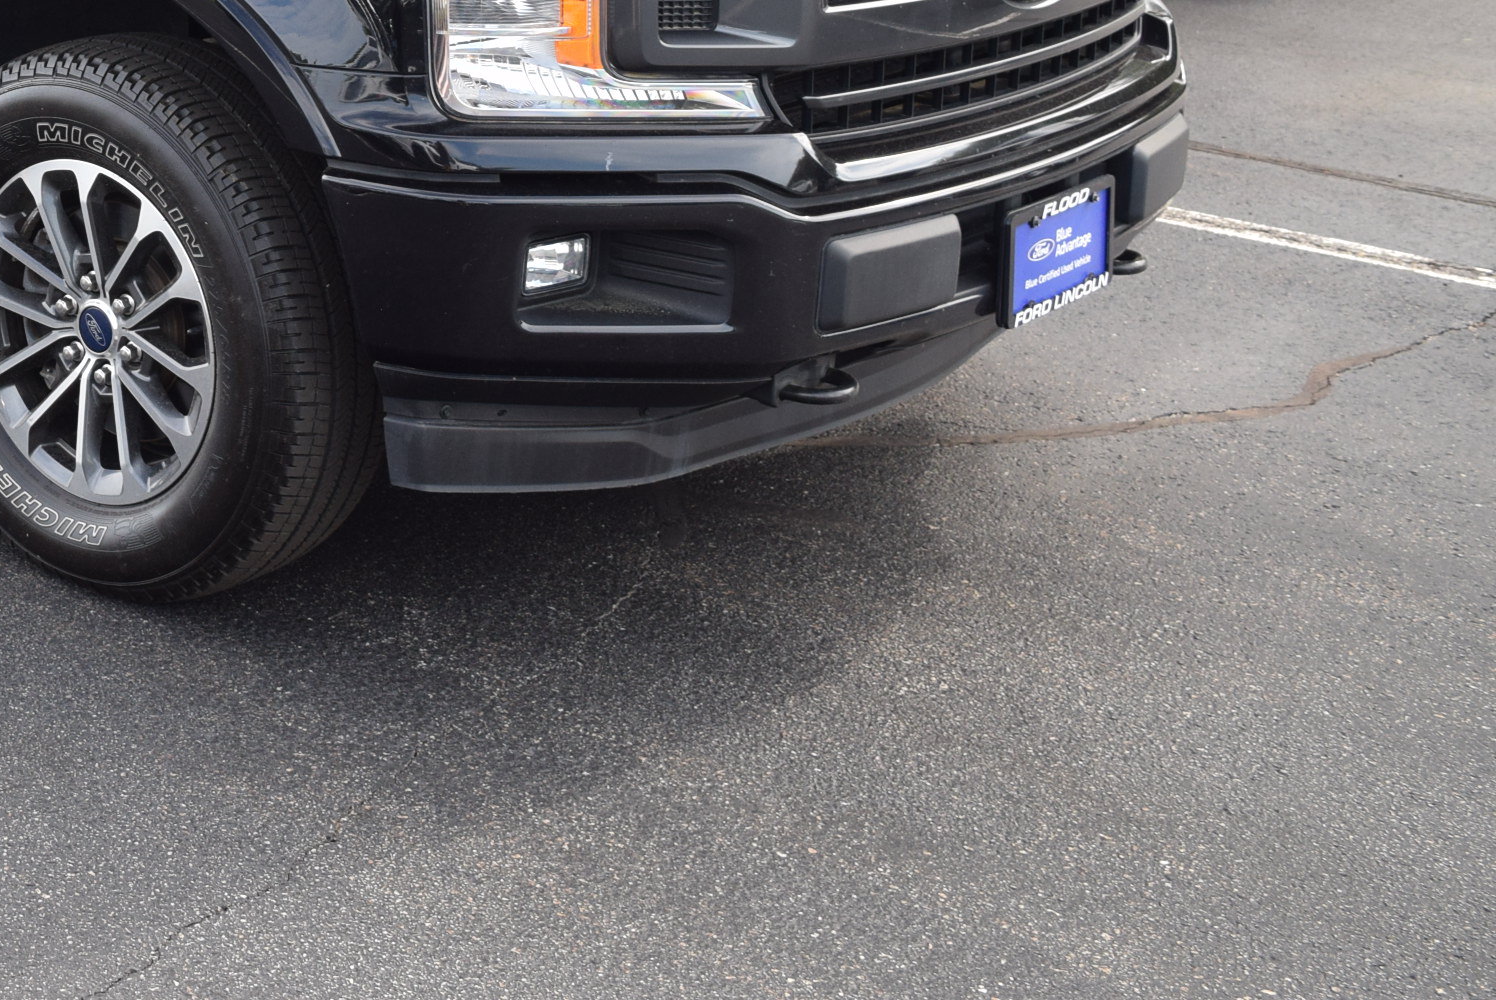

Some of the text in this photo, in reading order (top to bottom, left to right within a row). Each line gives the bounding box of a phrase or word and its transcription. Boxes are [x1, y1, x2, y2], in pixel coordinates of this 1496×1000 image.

[36, 121, 205, 259] MICHELIN
[1042, 187, 1091, 220] FLOOD
[1055, 226, 1073, 242] Blue
[1055, 232, 1092, 257] Advantage
[1024, 254, 1092, 290] Blue Certified Used Vehicle
[1014, 271, 1110, 328] FORD LINCOLN
